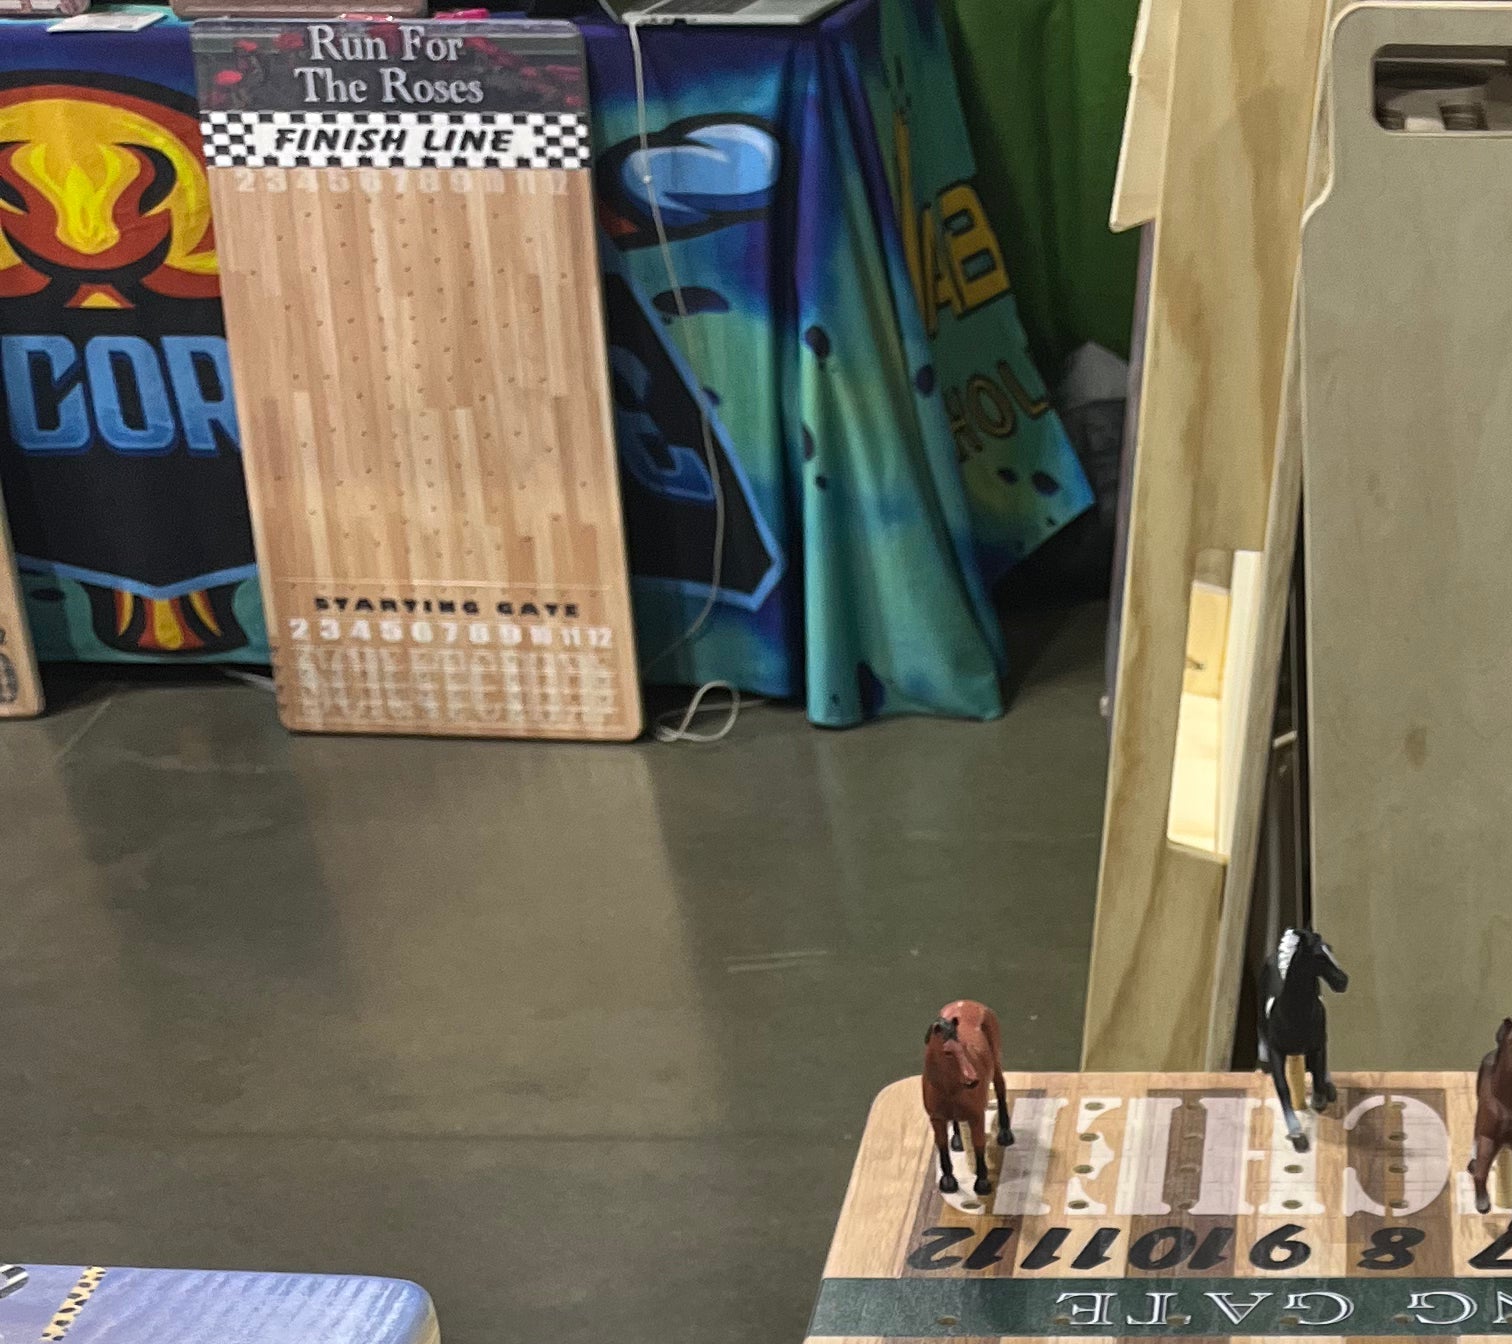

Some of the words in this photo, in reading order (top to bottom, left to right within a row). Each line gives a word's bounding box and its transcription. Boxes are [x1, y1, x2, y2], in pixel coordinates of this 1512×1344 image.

[307, 24, 389, 62] Run
[398, 24, 464, 62] For
[293, 66, 368, 104] The
[380, 66, 485, 105] Roses
[274, 128, 409, 152] FINISH
[423, 128, 515, 153] LINE
[235, 169, 255, 192] 2
[314, 597, 481, 616] STARTING
[496, 601, 580, 618] GATE
[288, 618, 310, 641] 2
[319, 618, 341, 642] 3
[350, 619, 372, 642] 4
[439, 622, 459, 643] 7
[907, 1227, 1019, 1271] 12
[1020, 1227, 1122, 1271] 11
[1128, 1227, 1236, 1271] 10
[1249, 1224, 1313, 1270] 9
[1356, 1227, 1426, 1270] 8
[1055, 1291, 1355, 1327] GATE
